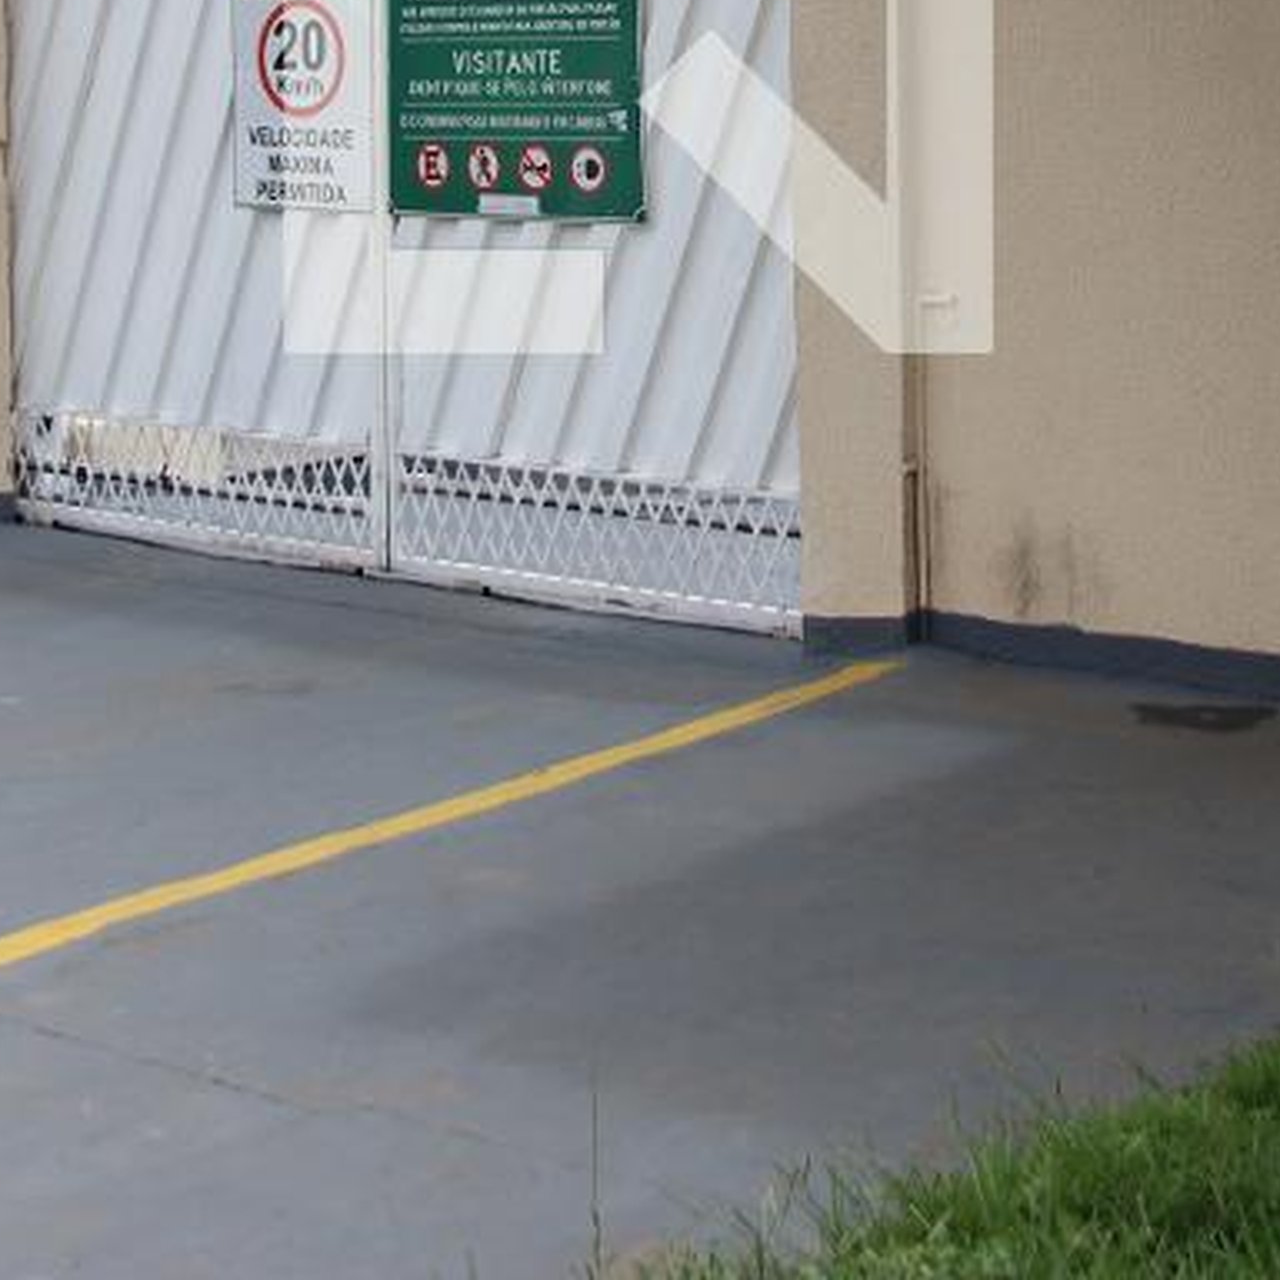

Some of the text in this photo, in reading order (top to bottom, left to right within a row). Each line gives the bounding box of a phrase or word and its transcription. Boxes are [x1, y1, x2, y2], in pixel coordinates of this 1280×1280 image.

[274, 19, 326, 71] 20
[452, 48, 562, 74] VISITANTE
[248, 125, 355, 150] VELOCIDADE
[255, 179, 348, 204] PERMITIDA
